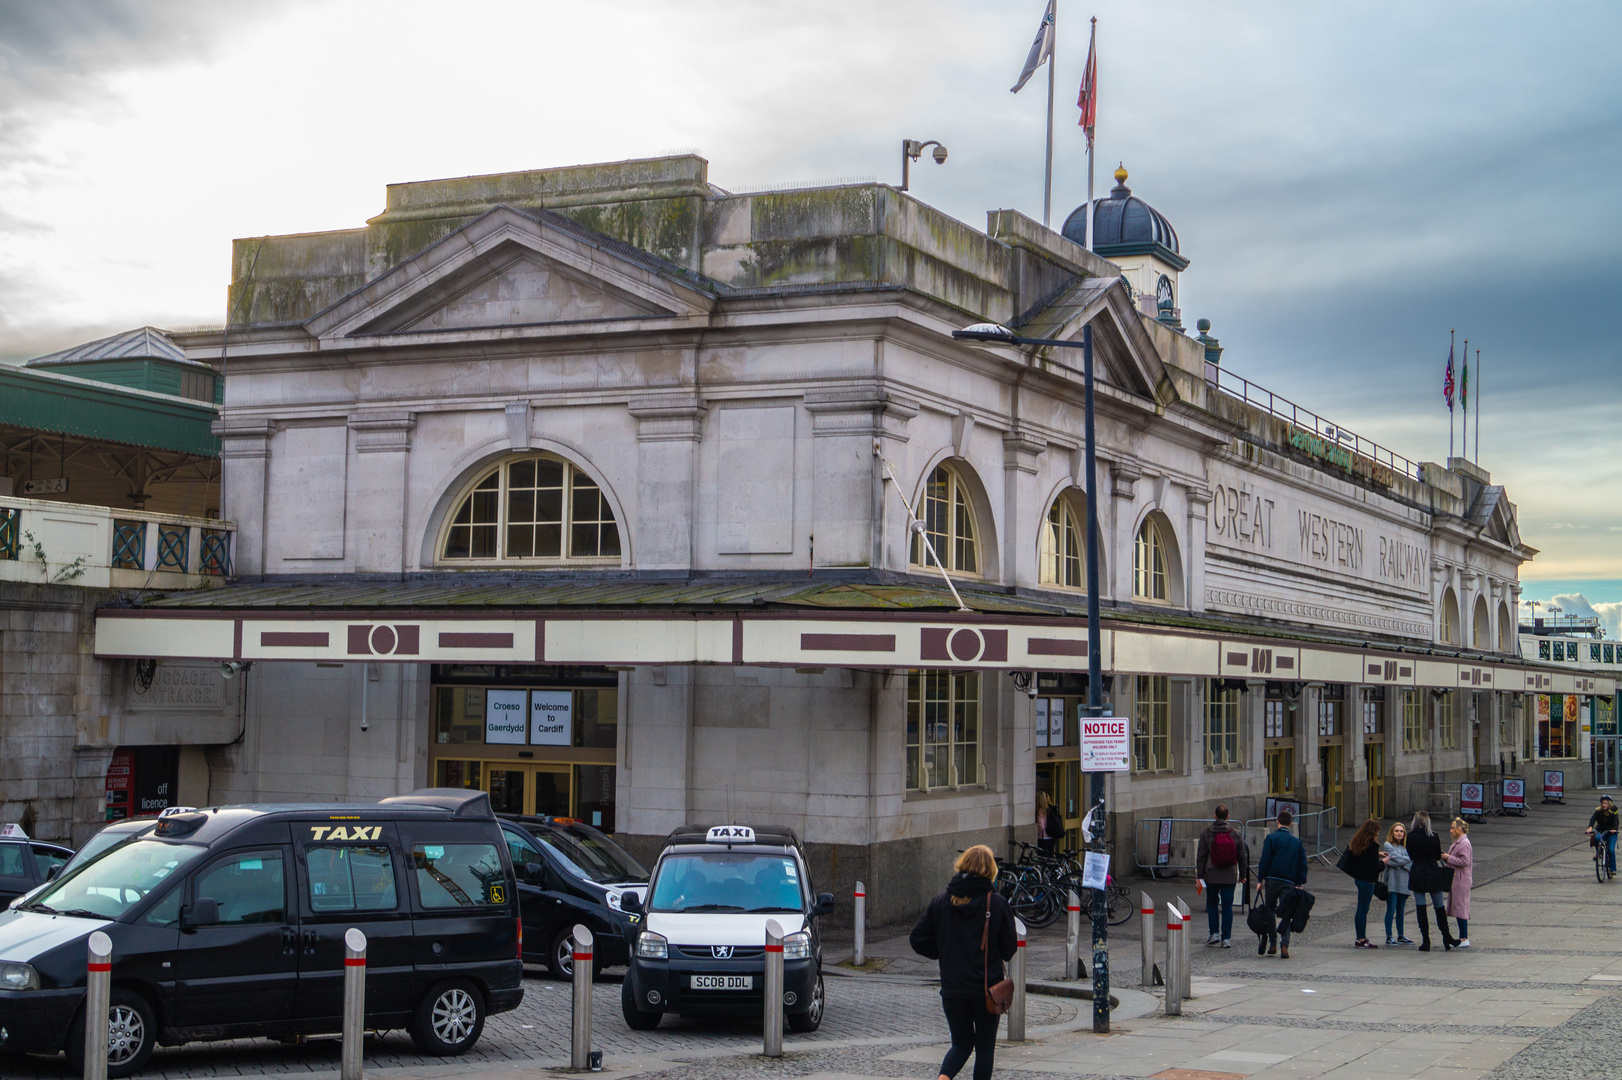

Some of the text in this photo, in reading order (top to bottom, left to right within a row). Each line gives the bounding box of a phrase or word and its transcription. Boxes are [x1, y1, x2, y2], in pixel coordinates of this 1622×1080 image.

[1214, 484, 1428, 586] GREAT WESTERN RAILWAY
[146, 669, 208, 686] UGGAGE
[493, 702, 520, 711] Croeso
[534, 703, 569, 711] Welcome
[547, 714, 556, 722] to
[488, 723, 525, 734] Gaerdydd
[538, 724, 564, 733] Cardiff
[1084, 723, 1125, 734] NOTICE
[157, 782, 168, 794] off
[141, 797, 168, 809] licence
[310, 826, 383, 840] TAXI
[712, 828, 750, 837] TAXI
[696, 977, 749, 988] SC08 DDL
